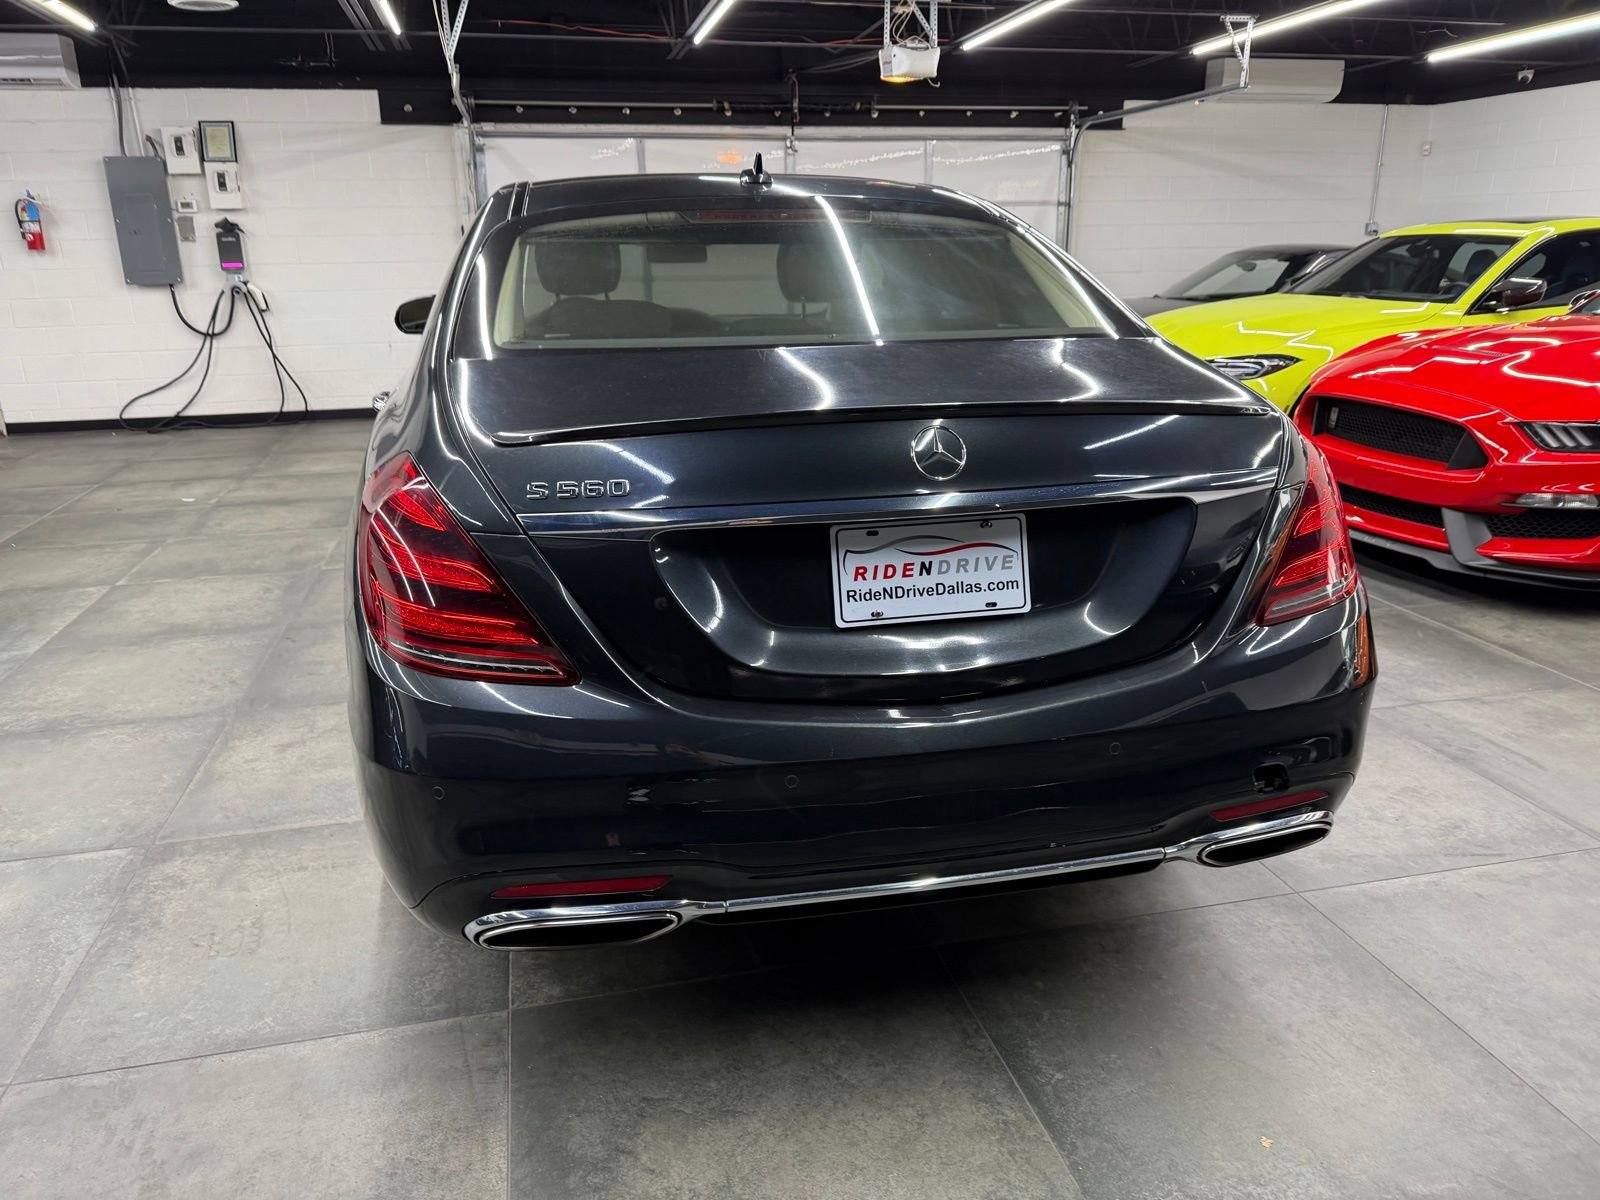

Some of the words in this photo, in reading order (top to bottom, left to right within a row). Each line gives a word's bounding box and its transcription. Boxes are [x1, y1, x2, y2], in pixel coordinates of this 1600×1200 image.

[526, 481, 549, 500] S
[556, 479, 630, 498] 560
[853, 554, 1015, 582] RIDENDRIVE
[846, 578, 1020, 604] RideNDriveDallas.com
